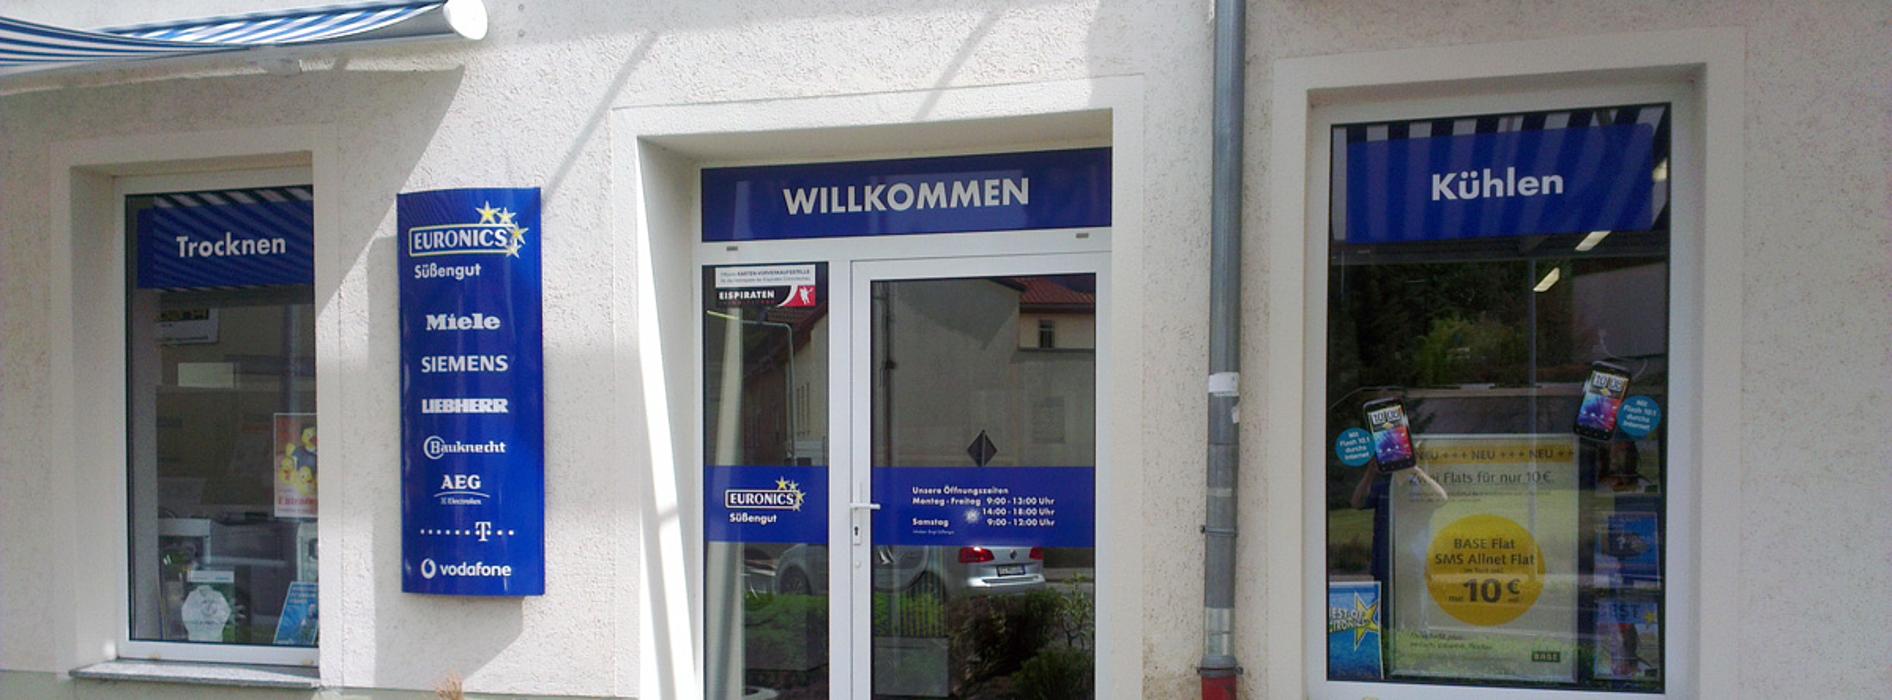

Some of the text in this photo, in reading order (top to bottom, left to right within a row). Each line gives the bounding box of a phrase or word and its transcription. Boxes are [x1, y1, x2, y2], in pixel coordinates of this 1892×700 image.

[1431, 167, 1564, 201] Kühlen
[783, 177, 1029, 215] WILLKOMMEN
[176, 232, 286, 258] Trocknen
[414, 229, 507, 250] EURONICS
[414, 263, 481, 280] Süßengut
[718, 290, 775, 300] EISPIRATEN
[426, 313, 501, 331] Miele
[421, 355, 509, 373] SIEMENS
[421, 398, 509, 414] LIEBHERR
[1623, 405, 1642, 413] Flash
[426, 438, 507, 456] Bauknecht
[1339, 438, 1358, 446] Flash
[1471, 450, 1495, 460] NEU
[1528, 449, 1553, 459] NEU
[441, 474, 482, 490] AEG
[1444, 471, 1473, 483] Flats
[1477, 471, 1494, 483] für
[1500, 474, 1521, 483] nur
[912, 486, 1009, 496] Unsere Öffnungszeiten
[730, 493, 794, 505] EURONICS
[912, 497, 945, 507] Montag
[950, 497, 981, 507] Freitag
[986, 497, 1006, 505] 9:00
[1039, 497, 1055, 505] Uhr
[729, 512, 777, 525] Süßengut
[983, 508, 1006, 516] 14:00
[1039, 508, 1055, 516] Uhr
[912, 517, 949, 527] Samstag
[986, 518, 1006, 526] 9:00
[1013, 518, 1037, 526] 12:00
[1039, 518, 1055, 526] Uhr
[475, 521, 491, 542] T
[1453, 538, 1515, 550] BASE Flat
[1435, 553, 1534, 565] SMS Allnet Flat
[440, 562, 512, 577] vodafone
[1463, 578, 1502, 604] 10
[1533, 653, 1559, 661] BASE
